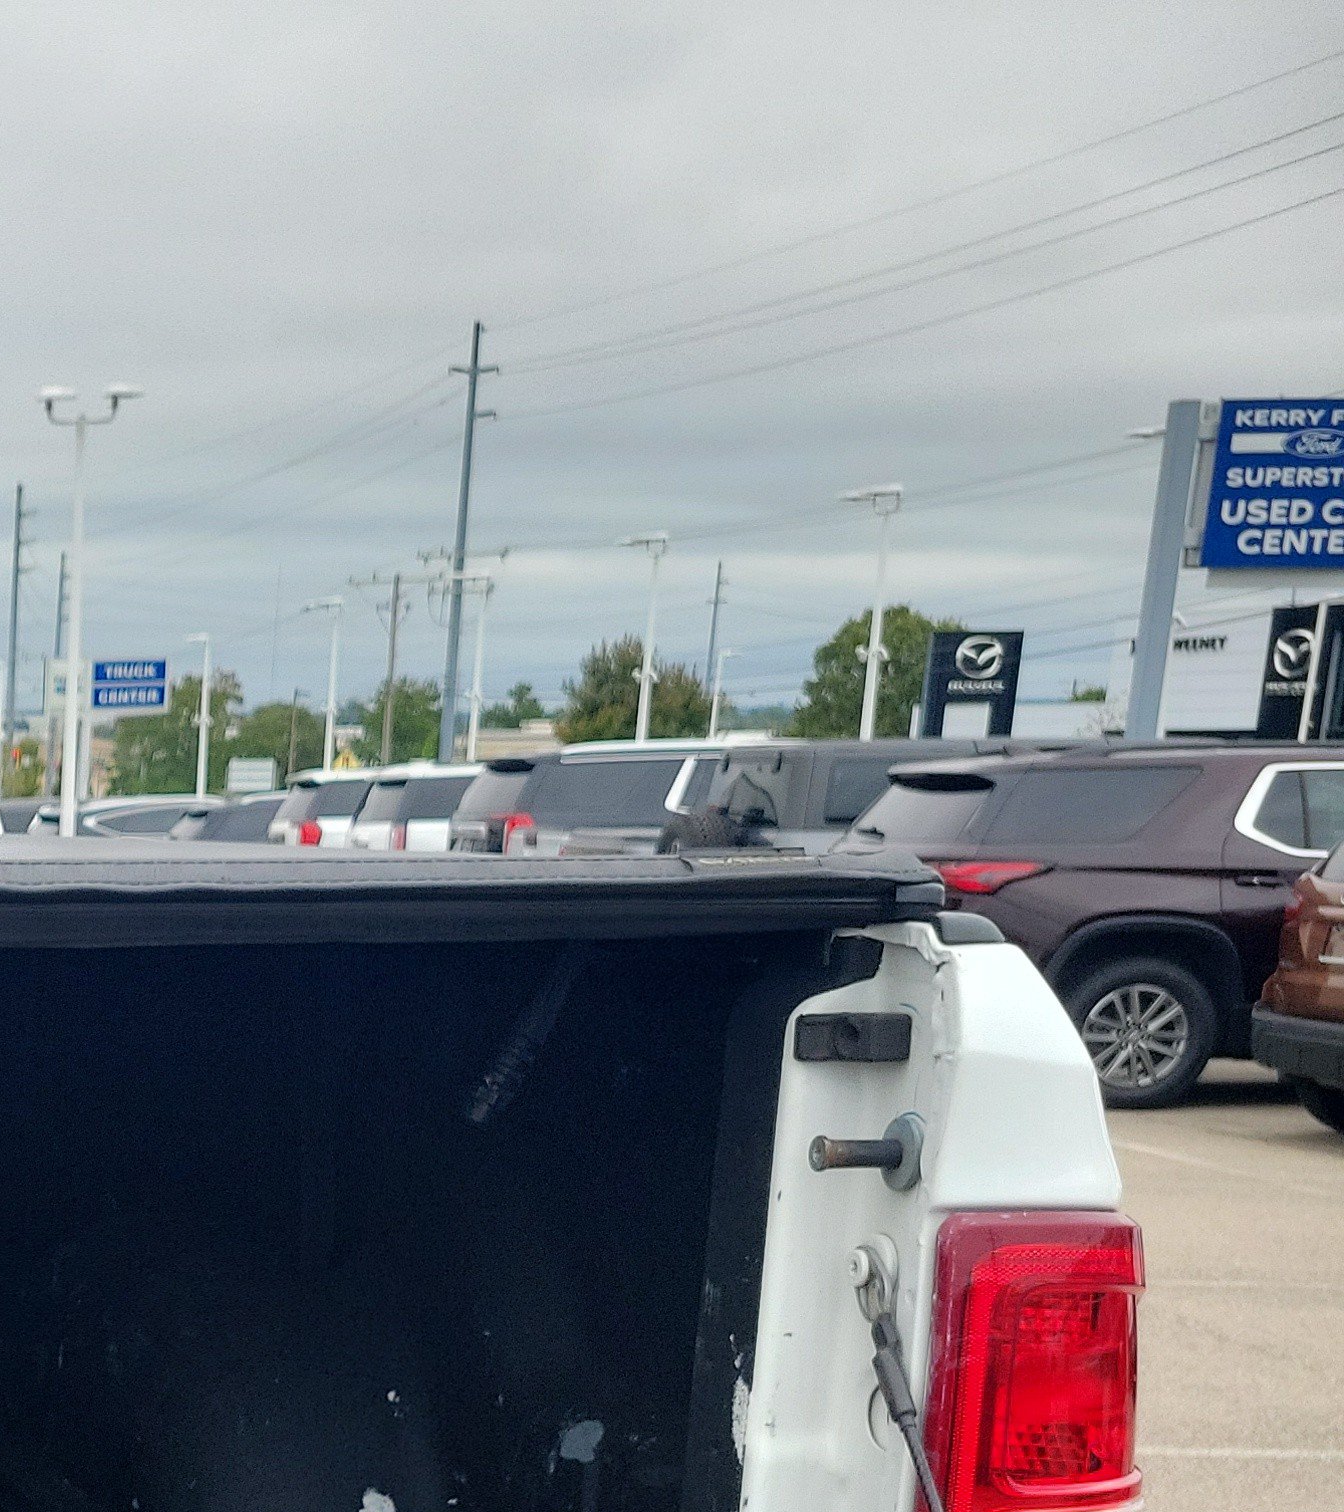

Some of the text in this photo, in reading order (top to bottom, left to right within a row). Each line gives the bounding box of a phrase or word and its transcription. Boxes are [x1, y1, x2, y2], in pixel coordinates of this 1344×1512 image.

[1234, 408, 1326, 428] KERRY
[1295, 431, 1344, 455] Ford
[1220, 499, 1314, 526] USED
